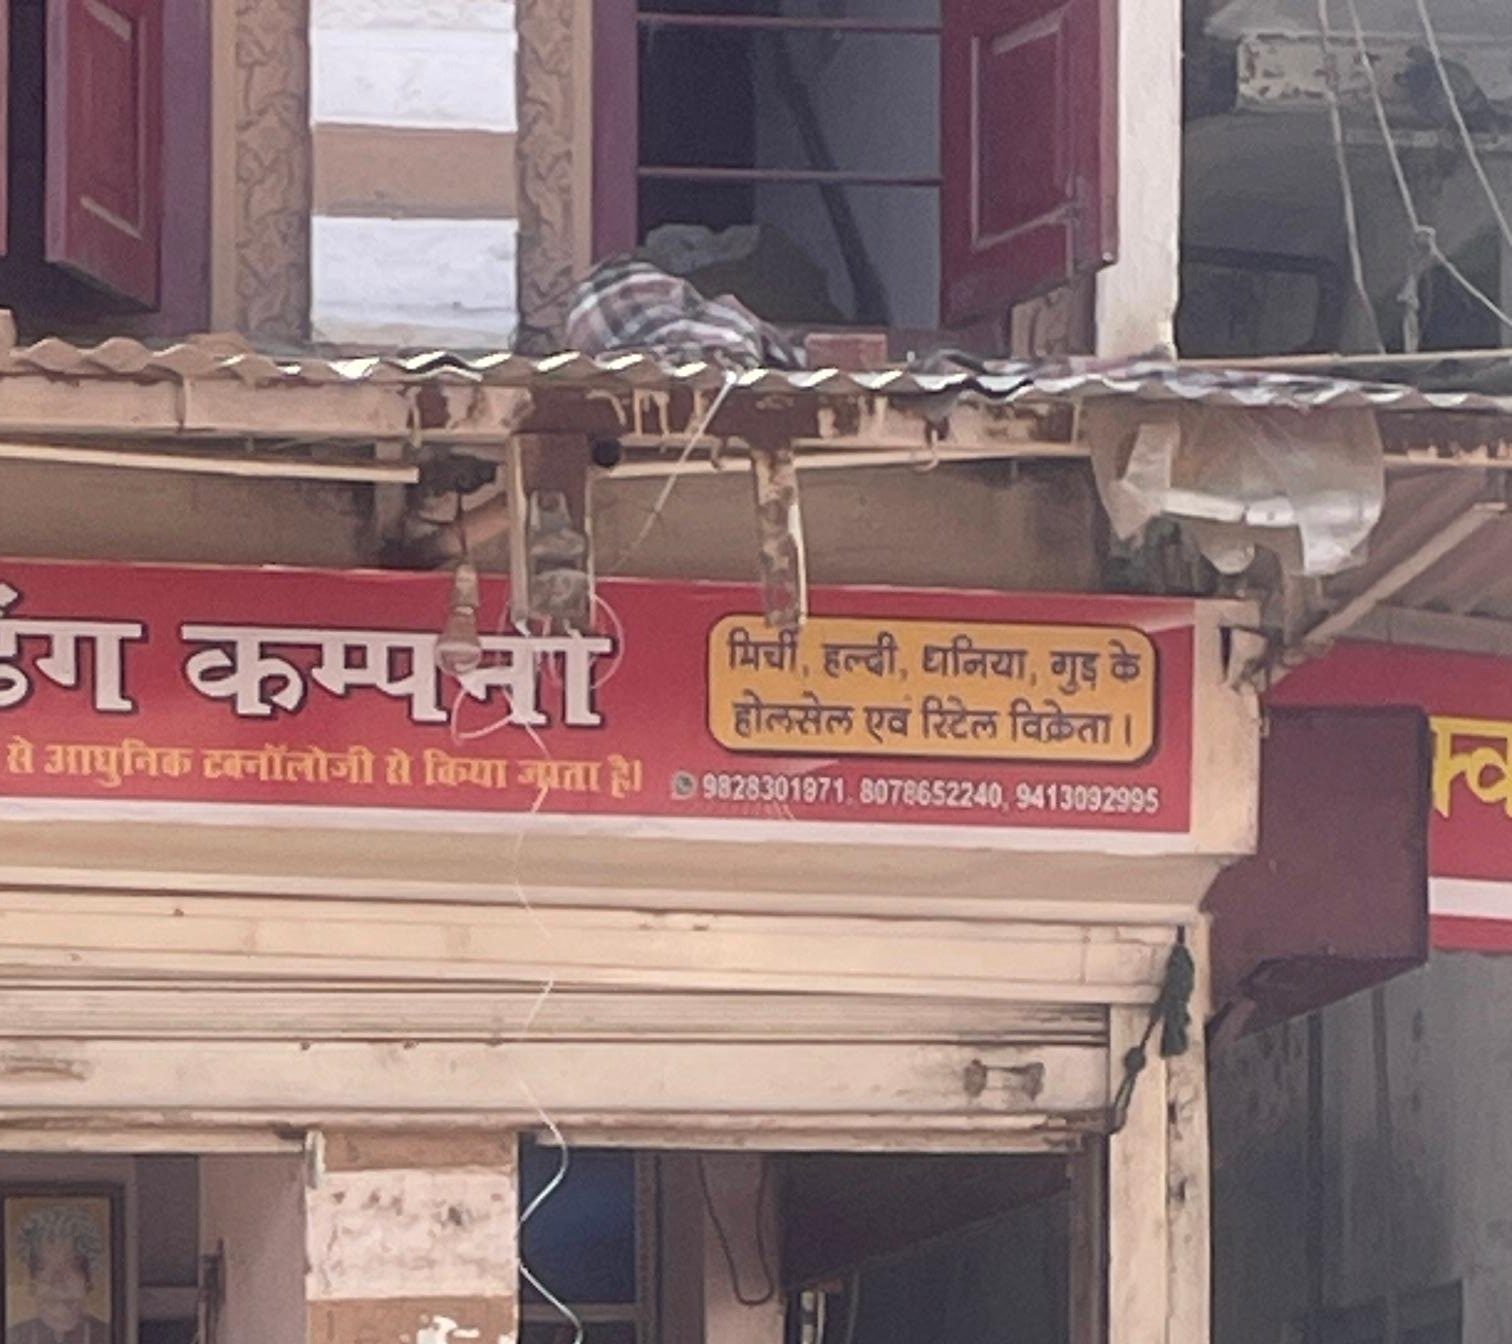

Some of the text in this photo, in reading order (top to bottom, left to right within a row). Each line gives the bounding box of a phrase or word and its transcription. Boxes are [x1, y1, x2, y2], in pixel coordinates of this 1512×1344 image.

[1049, 649, 1101, 696] गुड़
[1108, 638, 1142, 682] के
[731, 688, 855, 739] होलसेल
[862, 693, 913, 744] एवं
[920, 694, 1000, 740] रिटेल
[1007, 697, 1113, 745] विक्रेता
[6, 734, 36, 774] से
[43, 737, 193, 789] आधुनिक
[385, 746, 414, 786] से
[422, 747, 508, 789] किया
[516, 758, 603, 791] जाता
